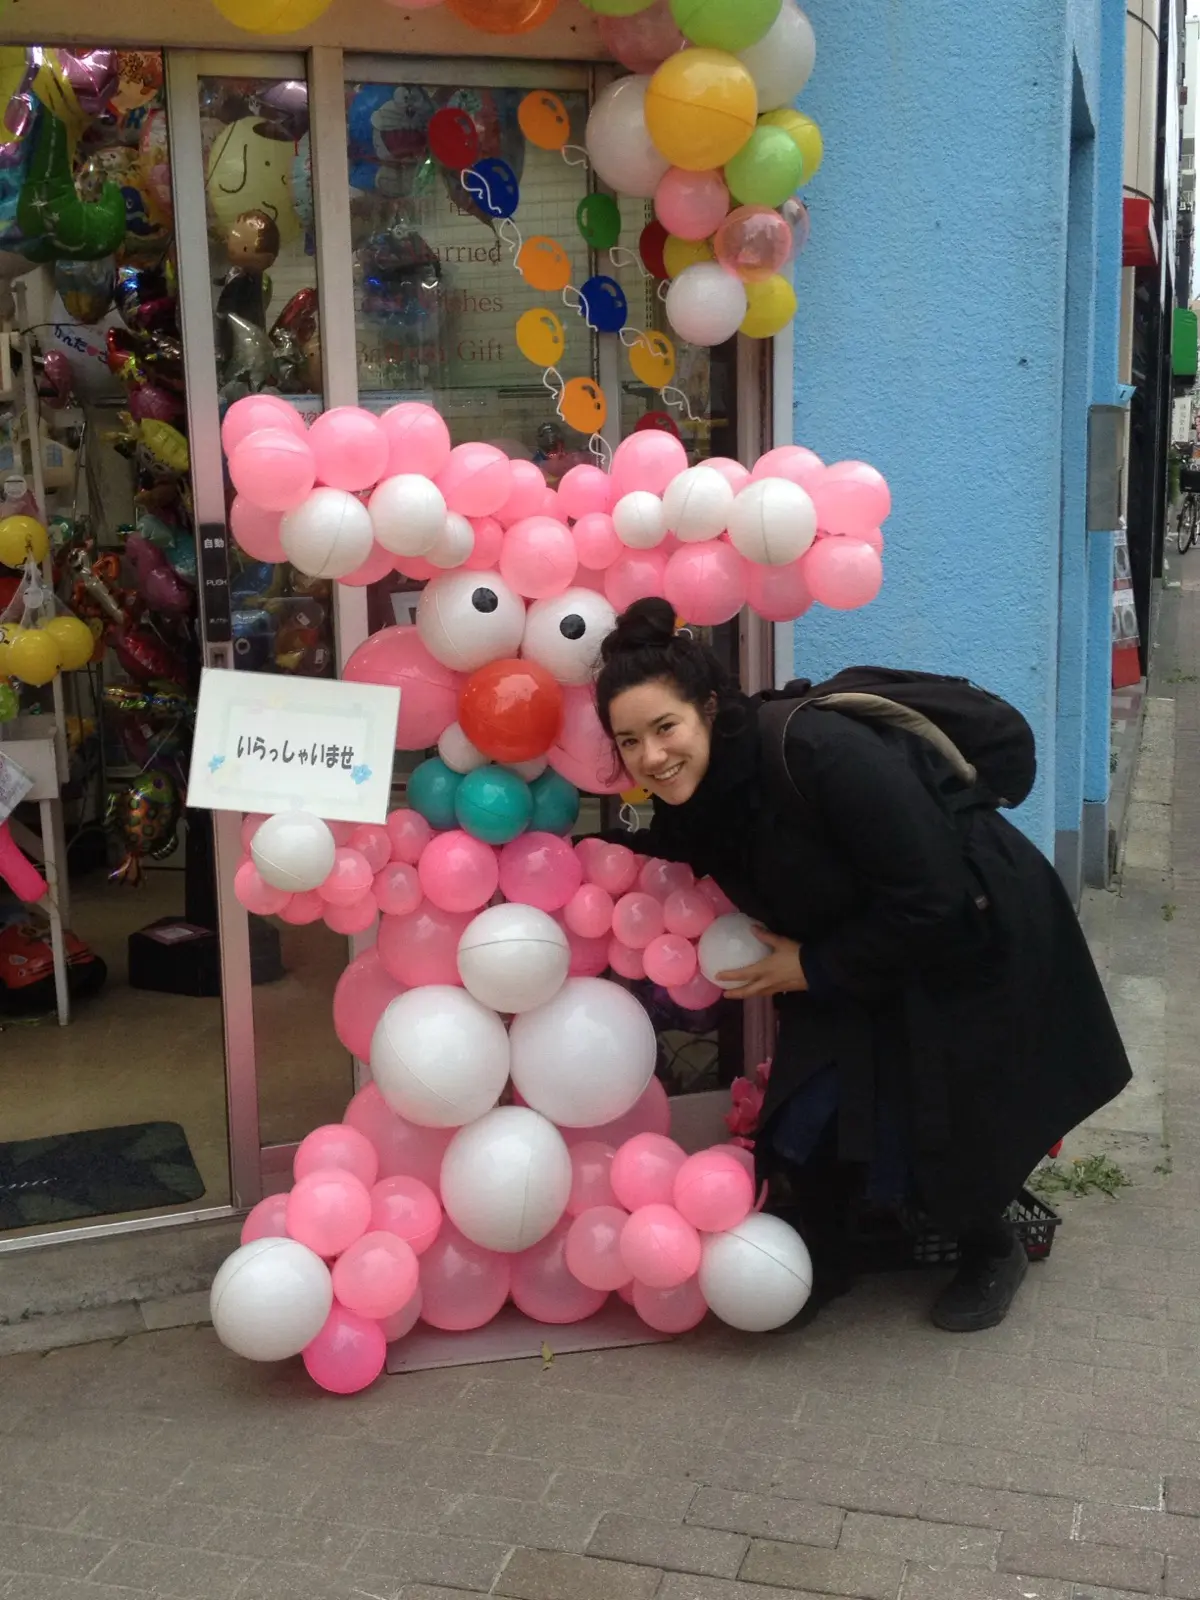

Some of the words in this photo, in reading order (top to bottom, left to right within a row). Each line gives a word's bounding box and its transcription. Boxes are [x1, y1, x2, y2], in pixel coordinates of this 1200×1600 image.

[426, 239, 502, 262] arried
[457, 338, 503, 362] Gift
[204, 538, 225, 549] 自動
[237, 735, 355, 770] いらっしゃいませ
